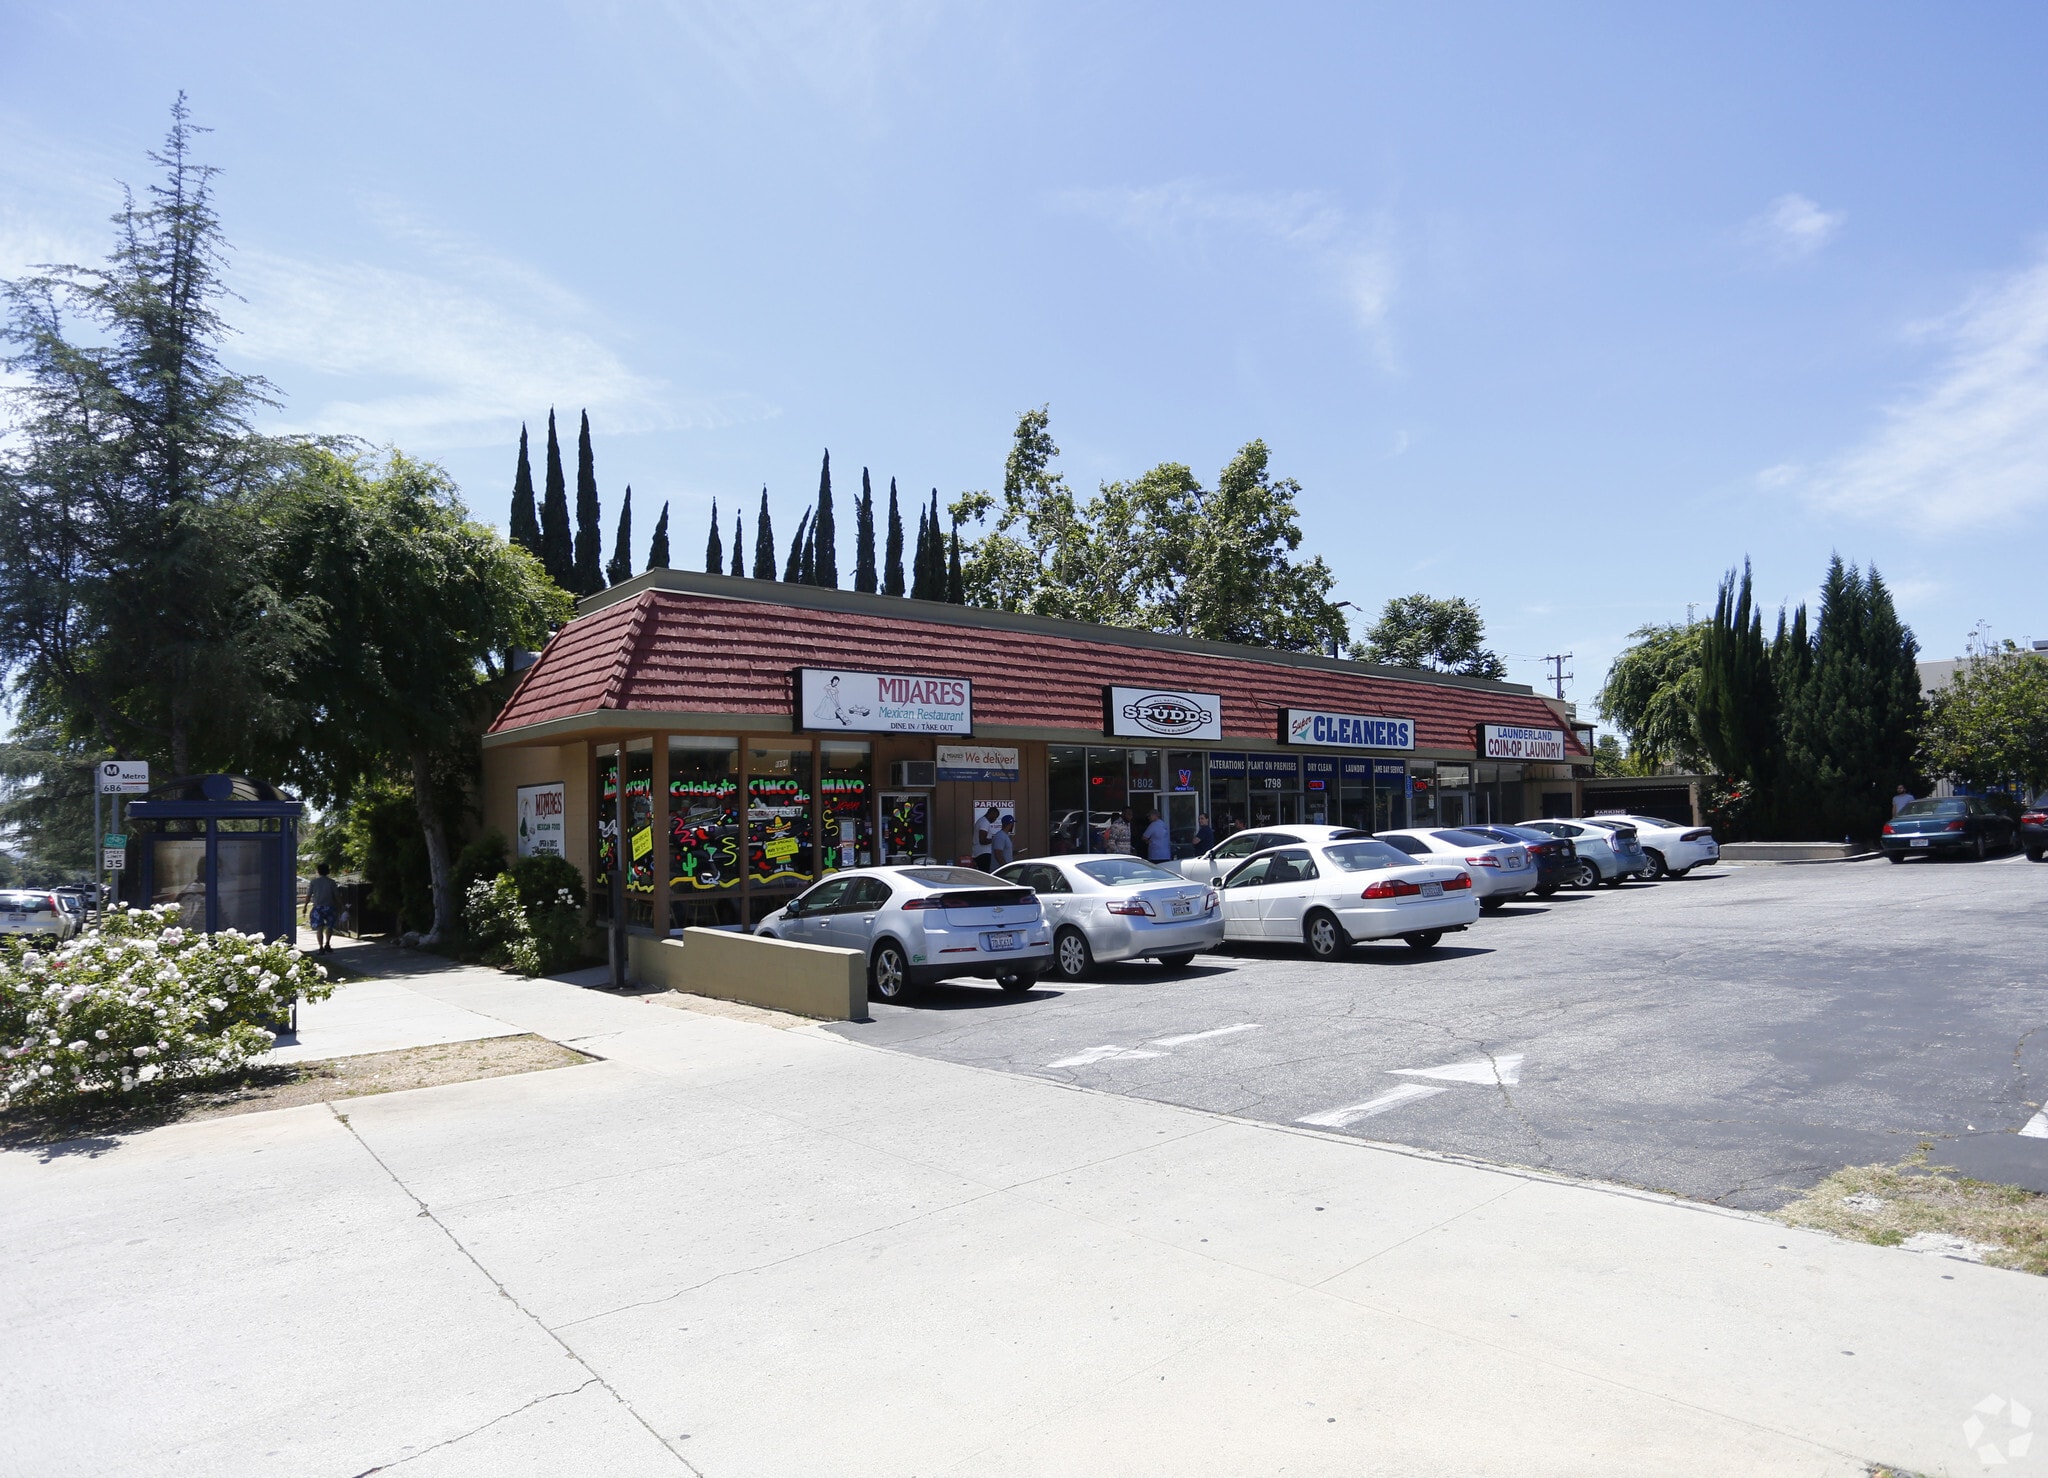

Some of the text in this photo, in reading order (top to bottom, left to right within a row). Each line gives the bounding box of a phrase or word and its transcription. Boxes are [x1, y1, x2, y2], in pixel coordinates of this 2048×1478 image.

[877, 677, 965, 707] MIJARES
[878, 706, 965, 721] Mexican Restaurant
[1123, 705, 1213, 724] SPUDDS
[921, 723, 938, 731] TAKE
[939, 724, 954, 732] OUT
[1292, 715, 1409, 746] Super CLEANERS
[1497, 727, 1552, 741] LAUNDERLAND
[1488, 738, 1561, 758] COIN-OP LAUNDRY
[965, 752, 980, 764] We
[982, 752, 1016, 765] deliver!
[1209, 760, 1245, 770] ALTERATIONS
[1248, 761, 1297, 771] PLANT ON PREMISES
[1307, 763, 1333, 772] DRY CLEAN
[1345, 764, 1365, 773] LAUNDRY
[103, 784, 121, 792] 686
[669, 779, 738, 799] Celebrate
[821, 779, 865, 794] MAYO
[1132, 778, 1153, 788] 1802
[1264, 778, 1282, 788] 1798
[793, 789, 811, 804] de
[106, 860, 122, 868] 35
